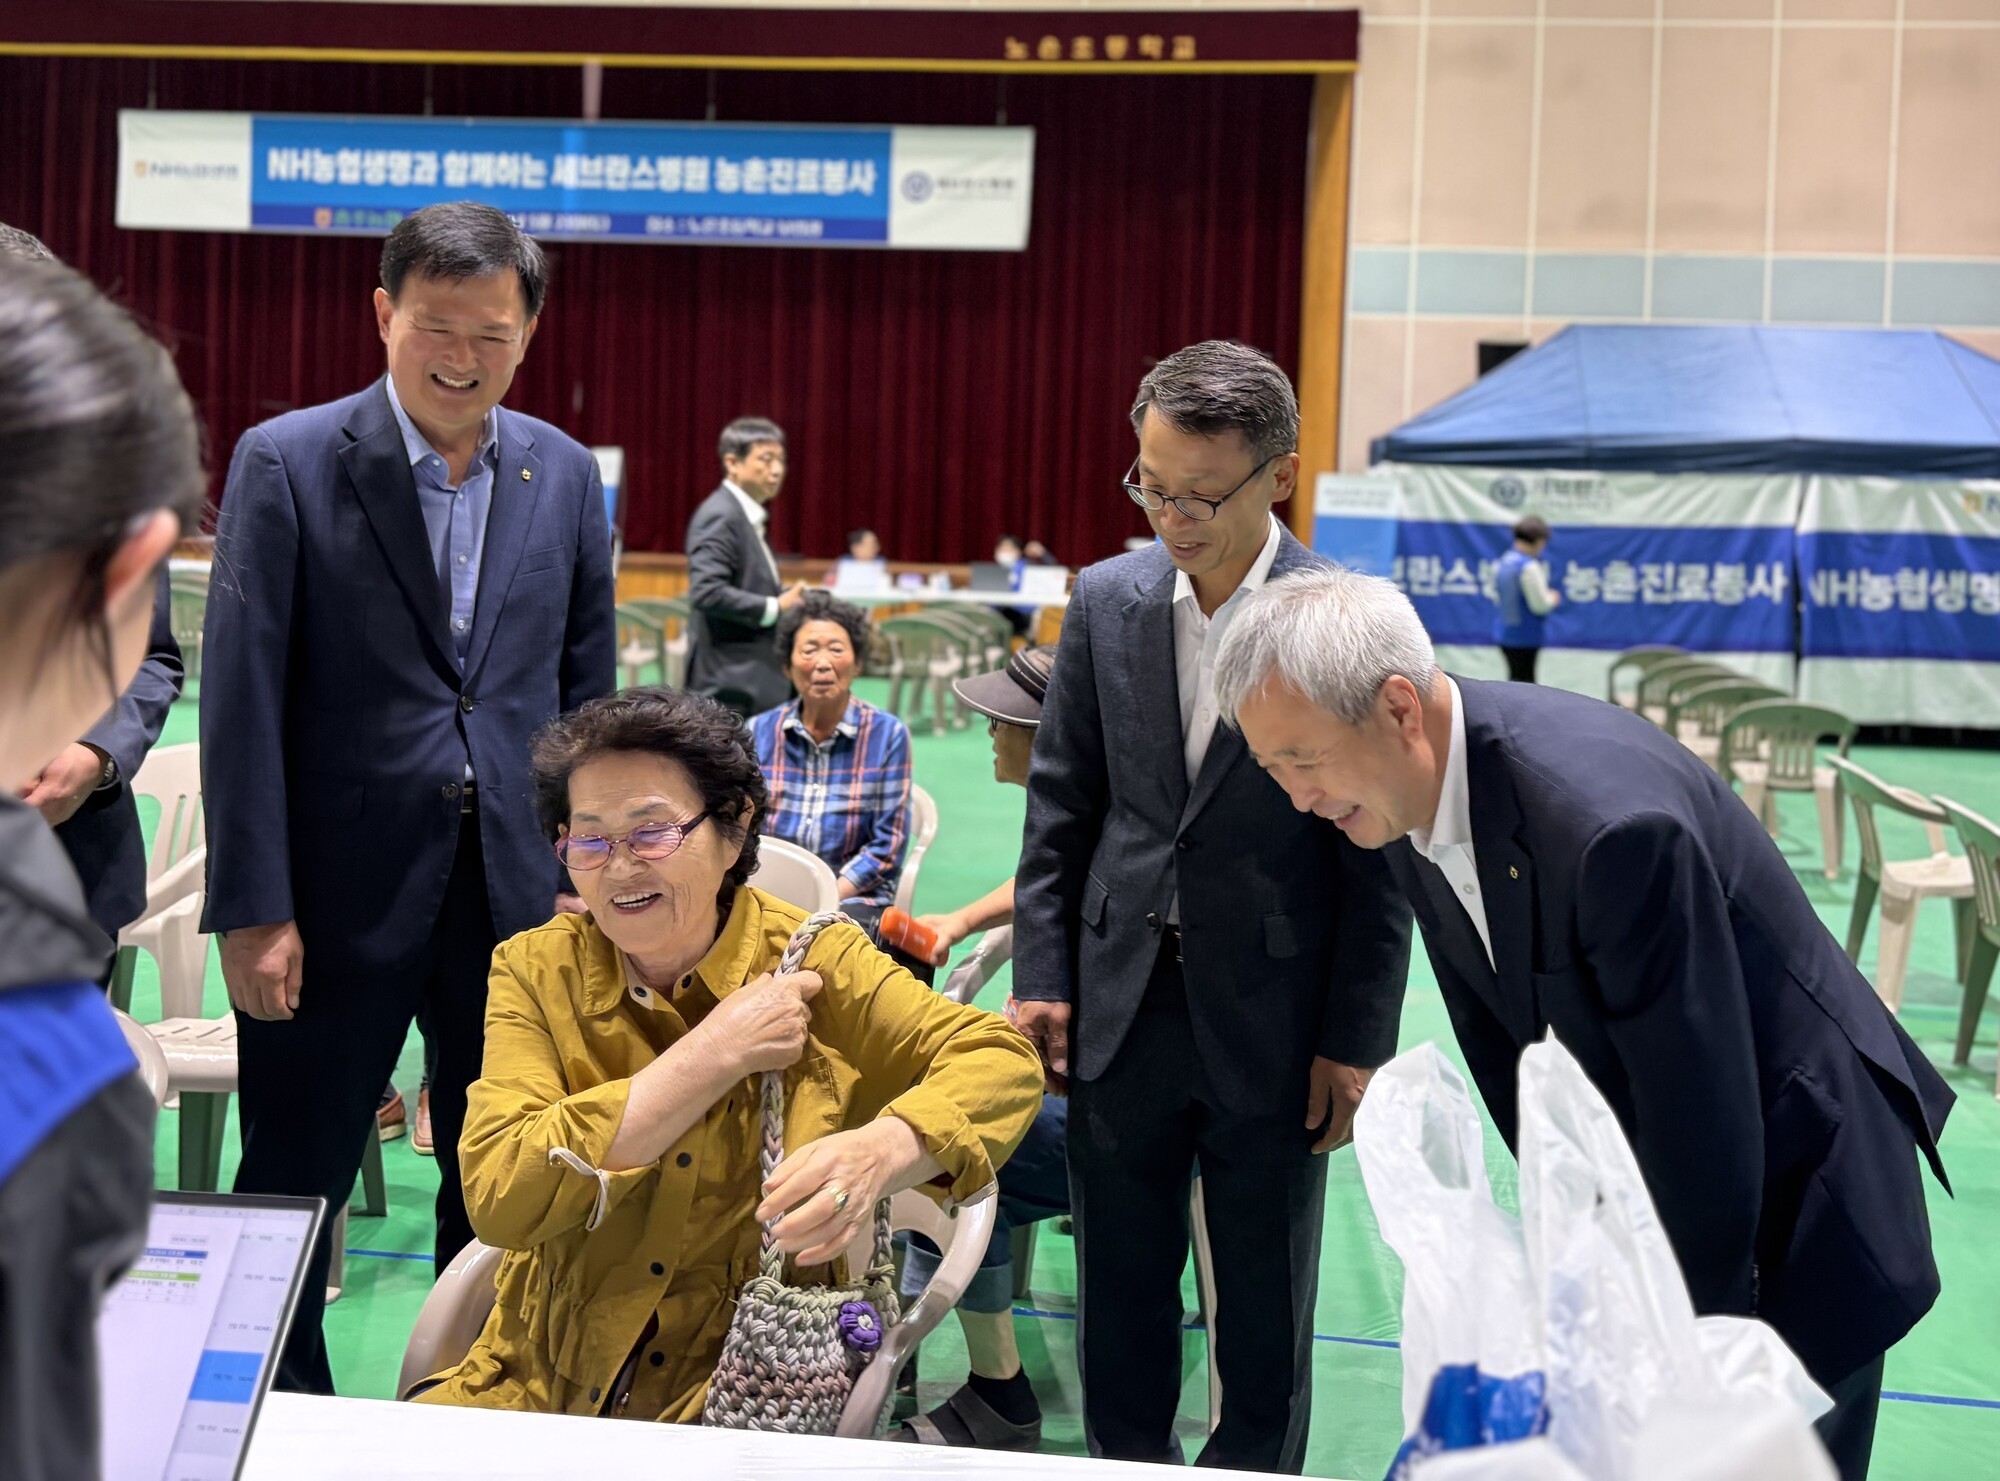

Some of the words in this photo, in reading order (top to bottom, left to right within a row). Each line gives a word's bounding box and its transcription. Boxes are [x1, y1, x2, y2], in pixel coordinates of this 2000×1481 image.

[267, 147, 438, 186] NH농협생명과
[443, 151, 547, 189] 함께하는
[551, 154, 709, 193] 세브란스병원
[715, 157, 878, 196] 농촌진료봉사
[1563, 559, 1788, 604] 농촌진료봉사
